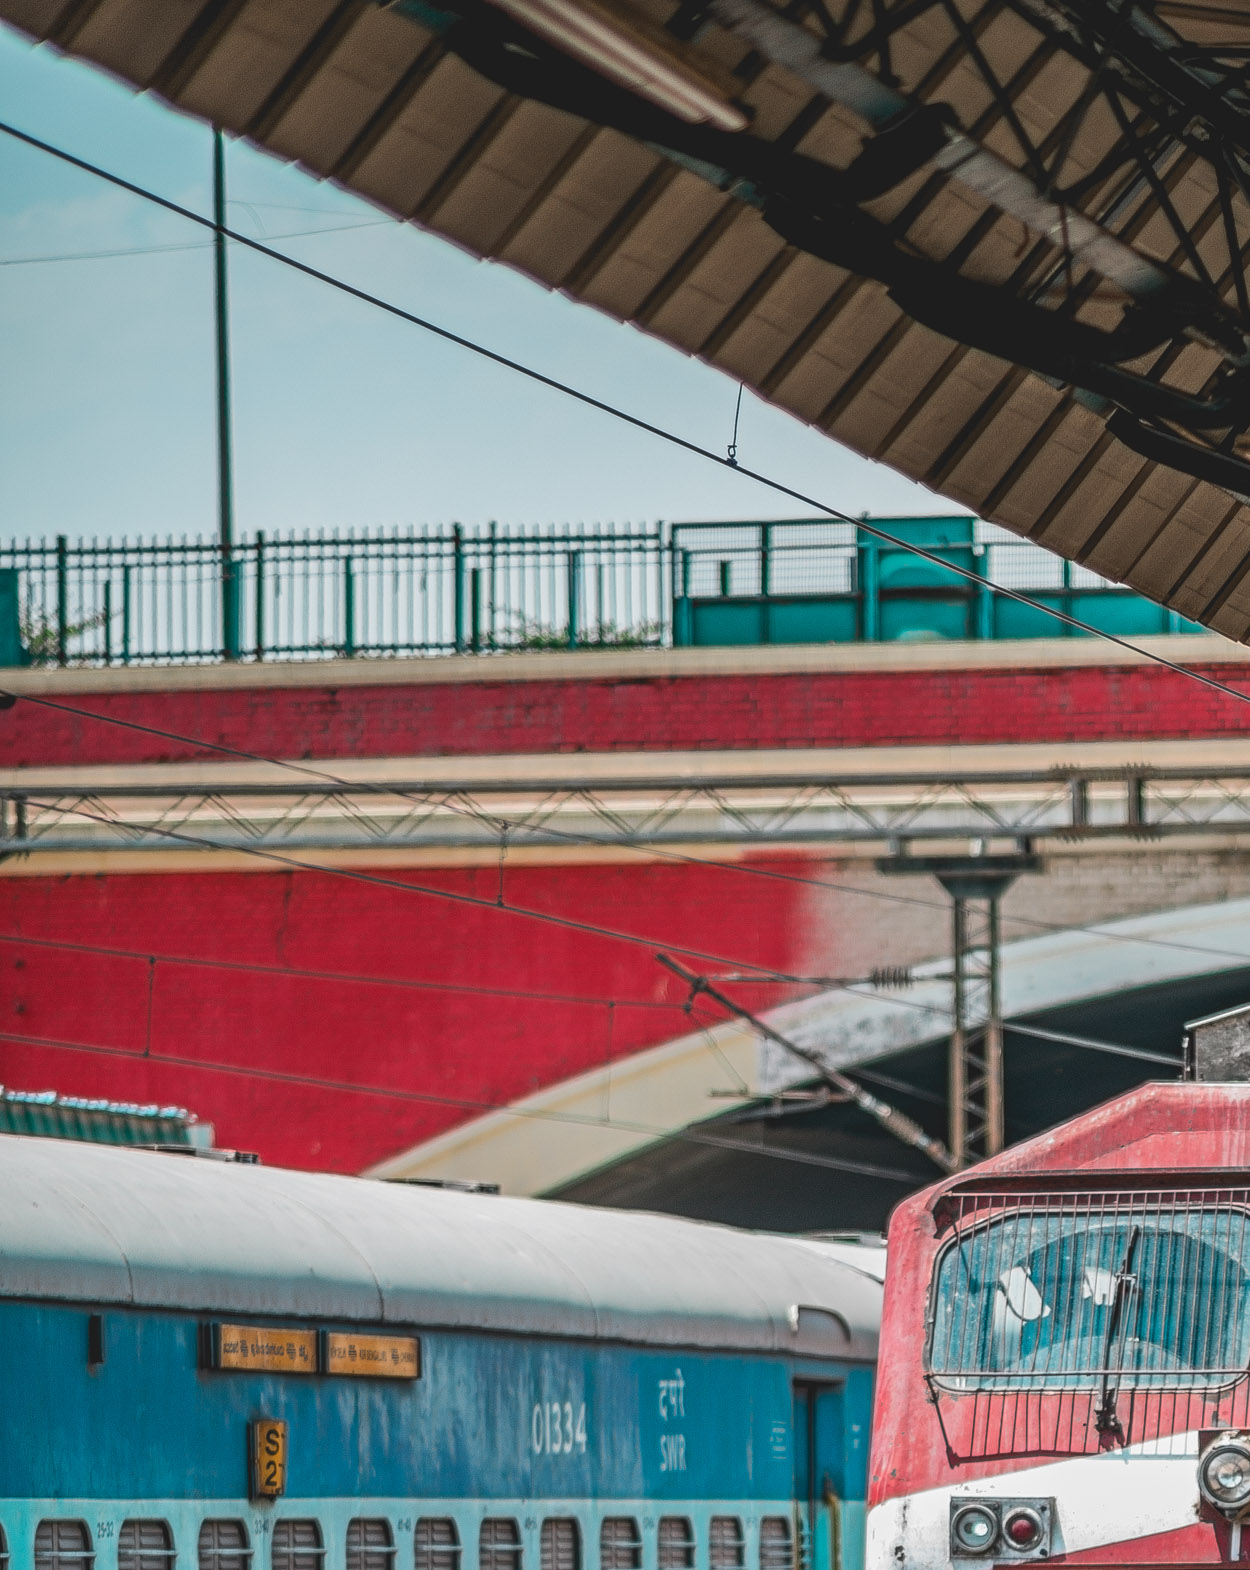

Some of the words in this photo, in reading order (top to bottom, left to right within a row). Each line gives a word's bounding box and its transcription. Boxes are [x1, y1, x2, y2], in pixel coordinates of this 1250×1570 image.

[265, 1429, 280, 1456] S
[532, 1401, 587, 1454] 01334
[659, 1434, 687, 1472] SWR
[265, 1460, 277, 1486] 2
